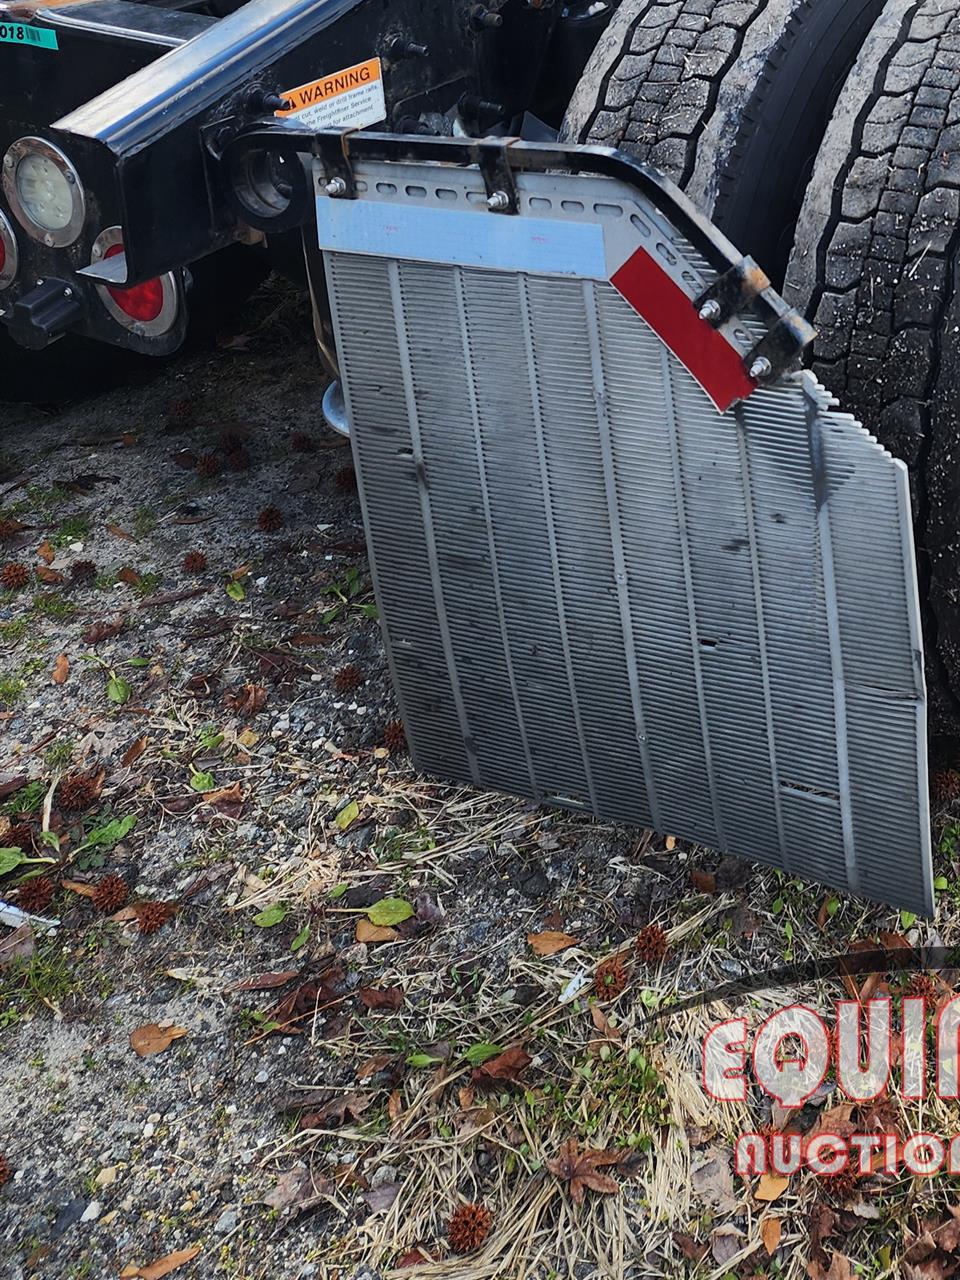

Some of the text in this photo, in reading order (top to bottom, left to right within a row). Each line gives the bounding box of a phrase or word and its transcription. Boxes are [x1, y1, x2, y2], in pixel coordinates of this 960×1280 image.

[299, 67, 370, 104] WARNING
[314, 103, 328, 114] weld
[336, 94, 347, 105] drill
[348, 89, 364, 99] frame
[351, 96, 371, 109] Service
[342, 105, 373, 122] attachment
